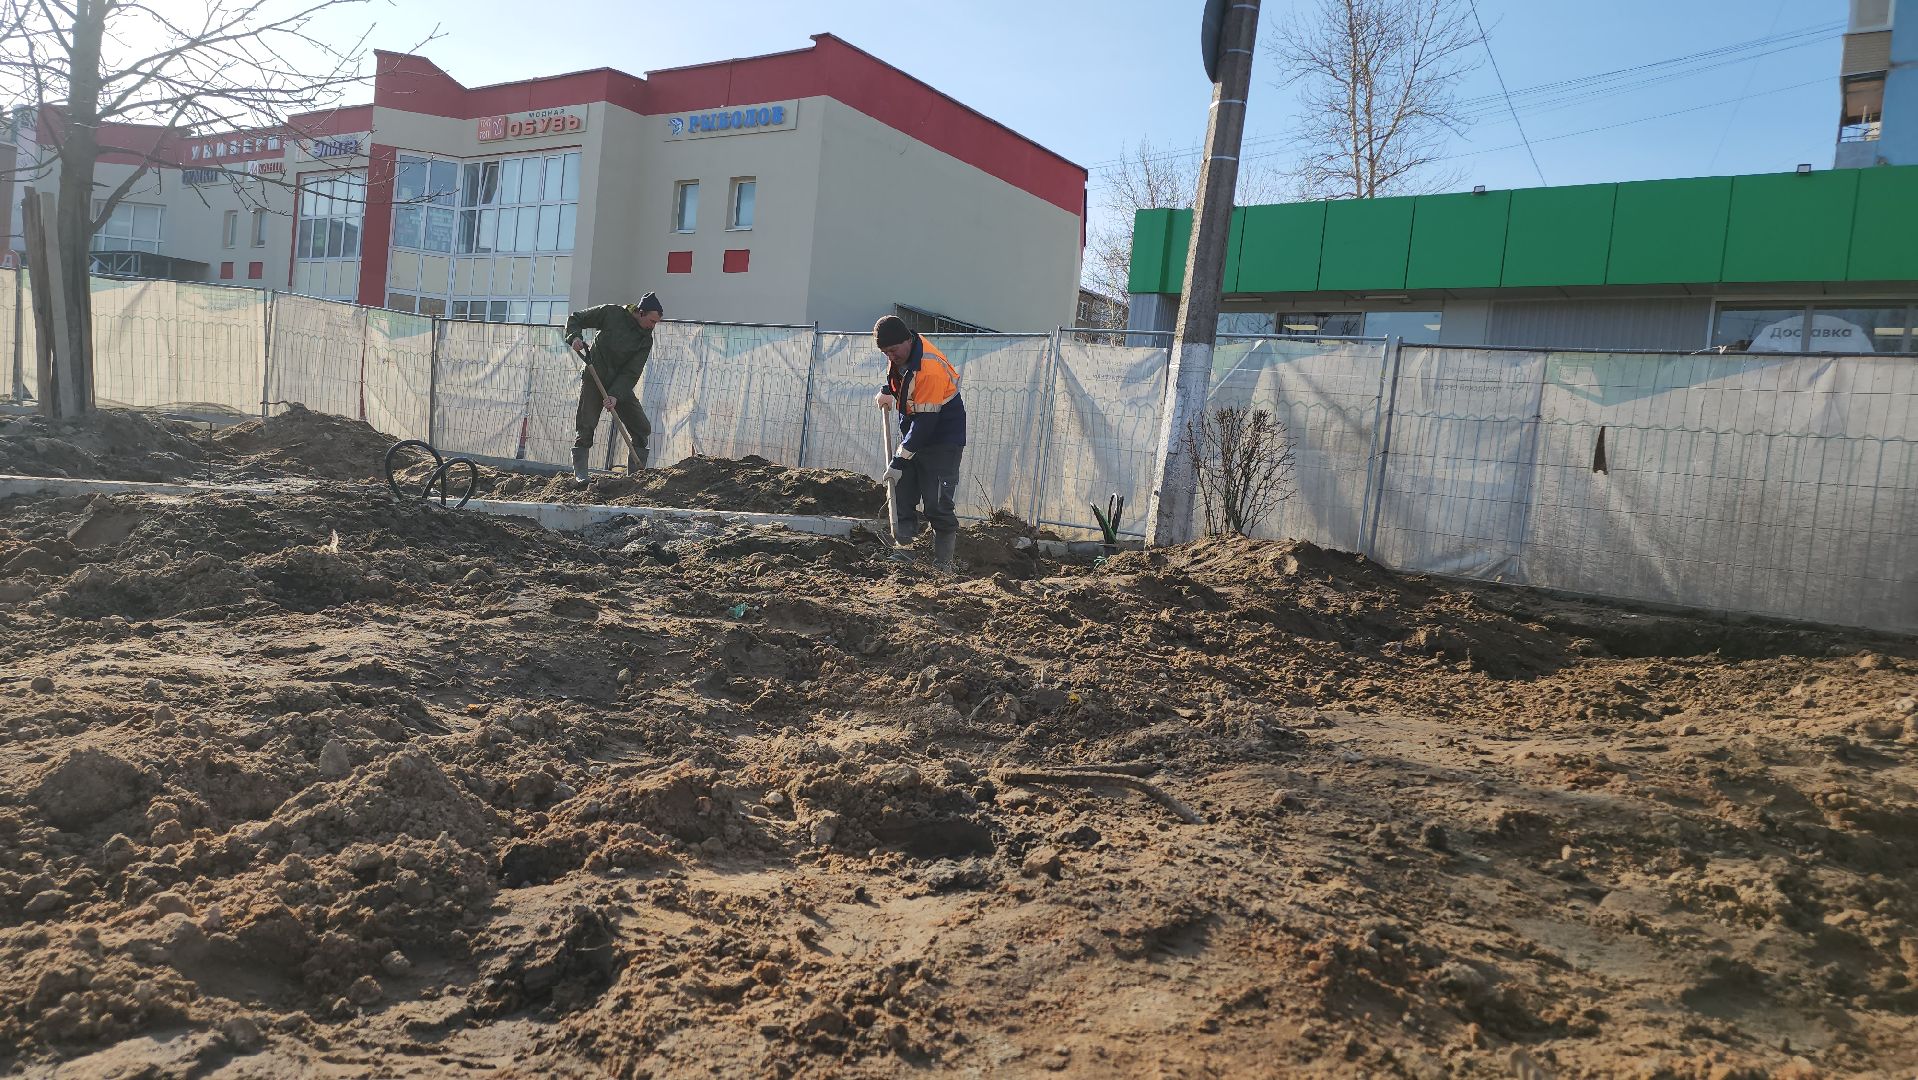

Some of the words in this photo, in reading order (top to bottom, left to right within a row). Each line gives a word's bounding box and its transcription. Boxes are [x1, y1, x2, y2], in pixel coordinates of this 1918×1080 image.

[528, 108, 565, 118] МОДНАЯ
[688, 106, 784, 133] РЫБОЛОВ
[510, 115, 581, 138] ОБУВЬ
[191, 136, 286, 160] УНИВЕРМ
[1770, 327, 1852, 339] Досавка
